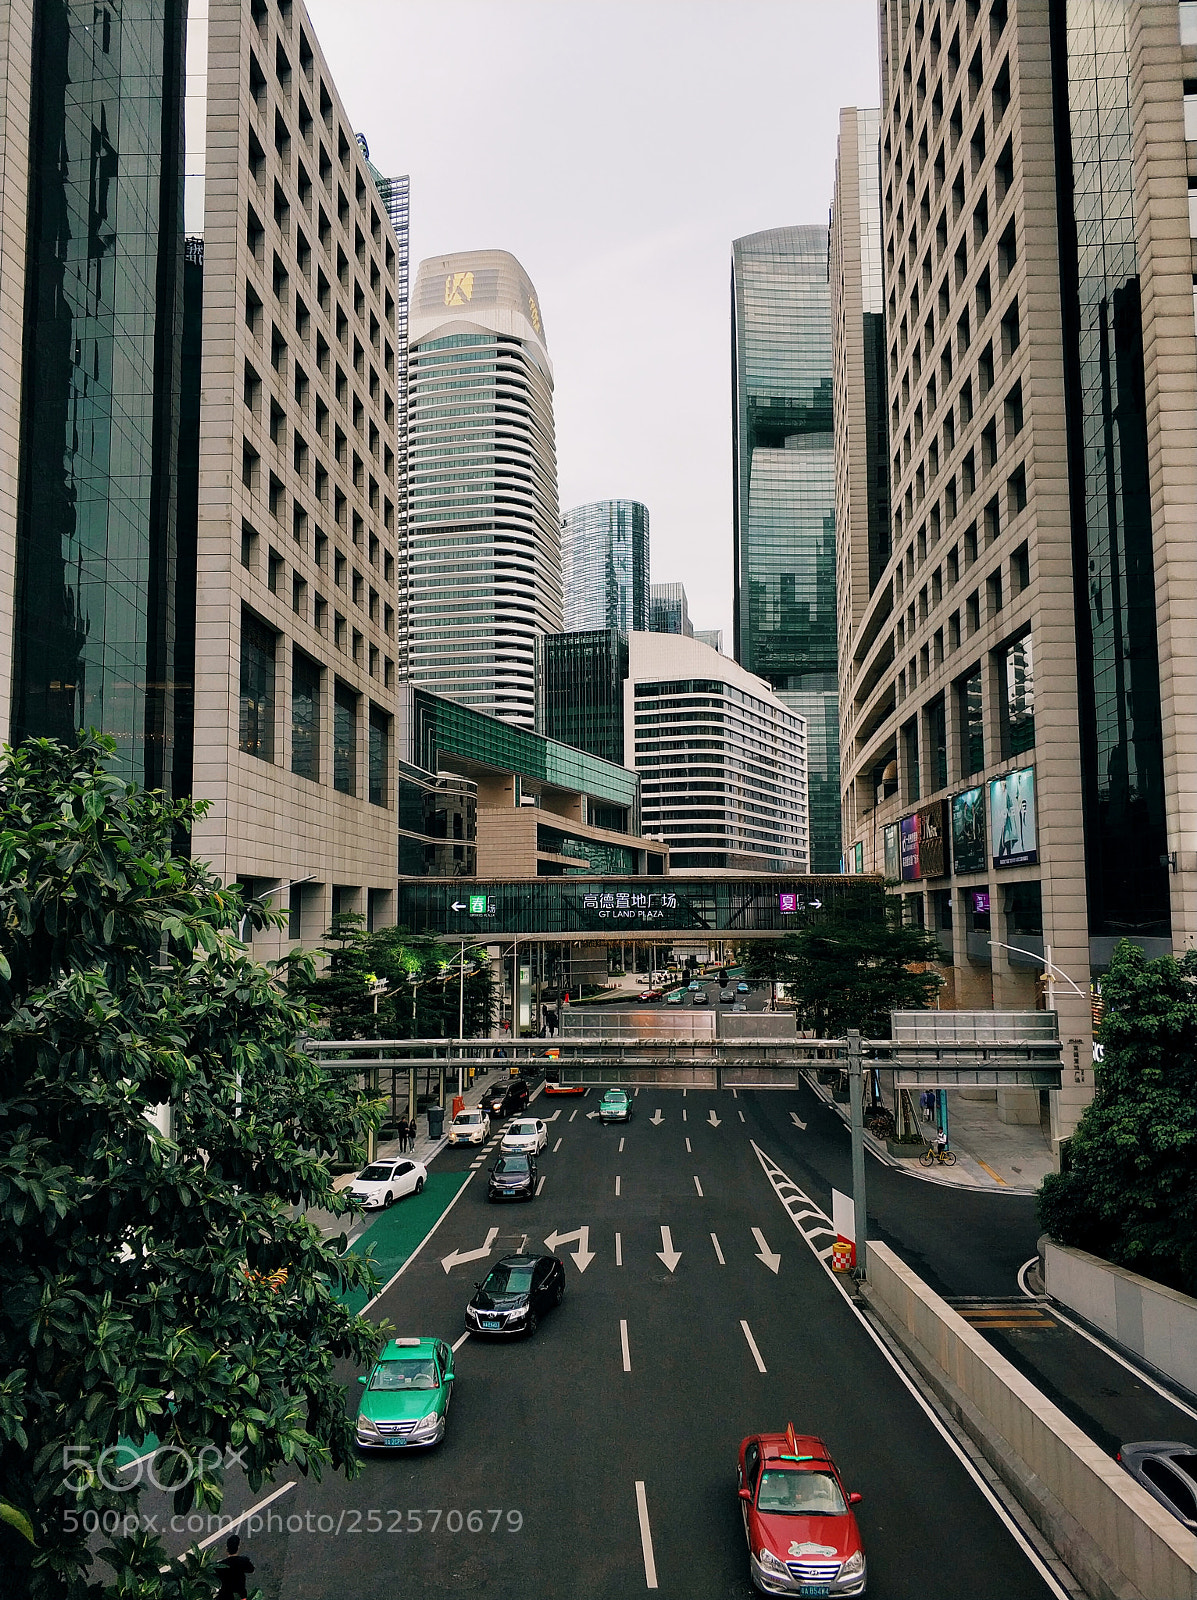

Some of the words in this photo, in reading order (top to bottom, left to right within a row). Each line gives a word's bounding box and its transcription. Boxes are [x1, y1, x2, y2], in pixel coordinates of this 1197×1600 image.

[471, 897, 484, 913] 春
[583, 893, 677, 909] 高德置地广场
[781, 894, 795, 910] 夏
[598, 910, 611, 918] GT
[612, 910, 636, 918] LAND
[637, 910, 664, 918] PLAZA
